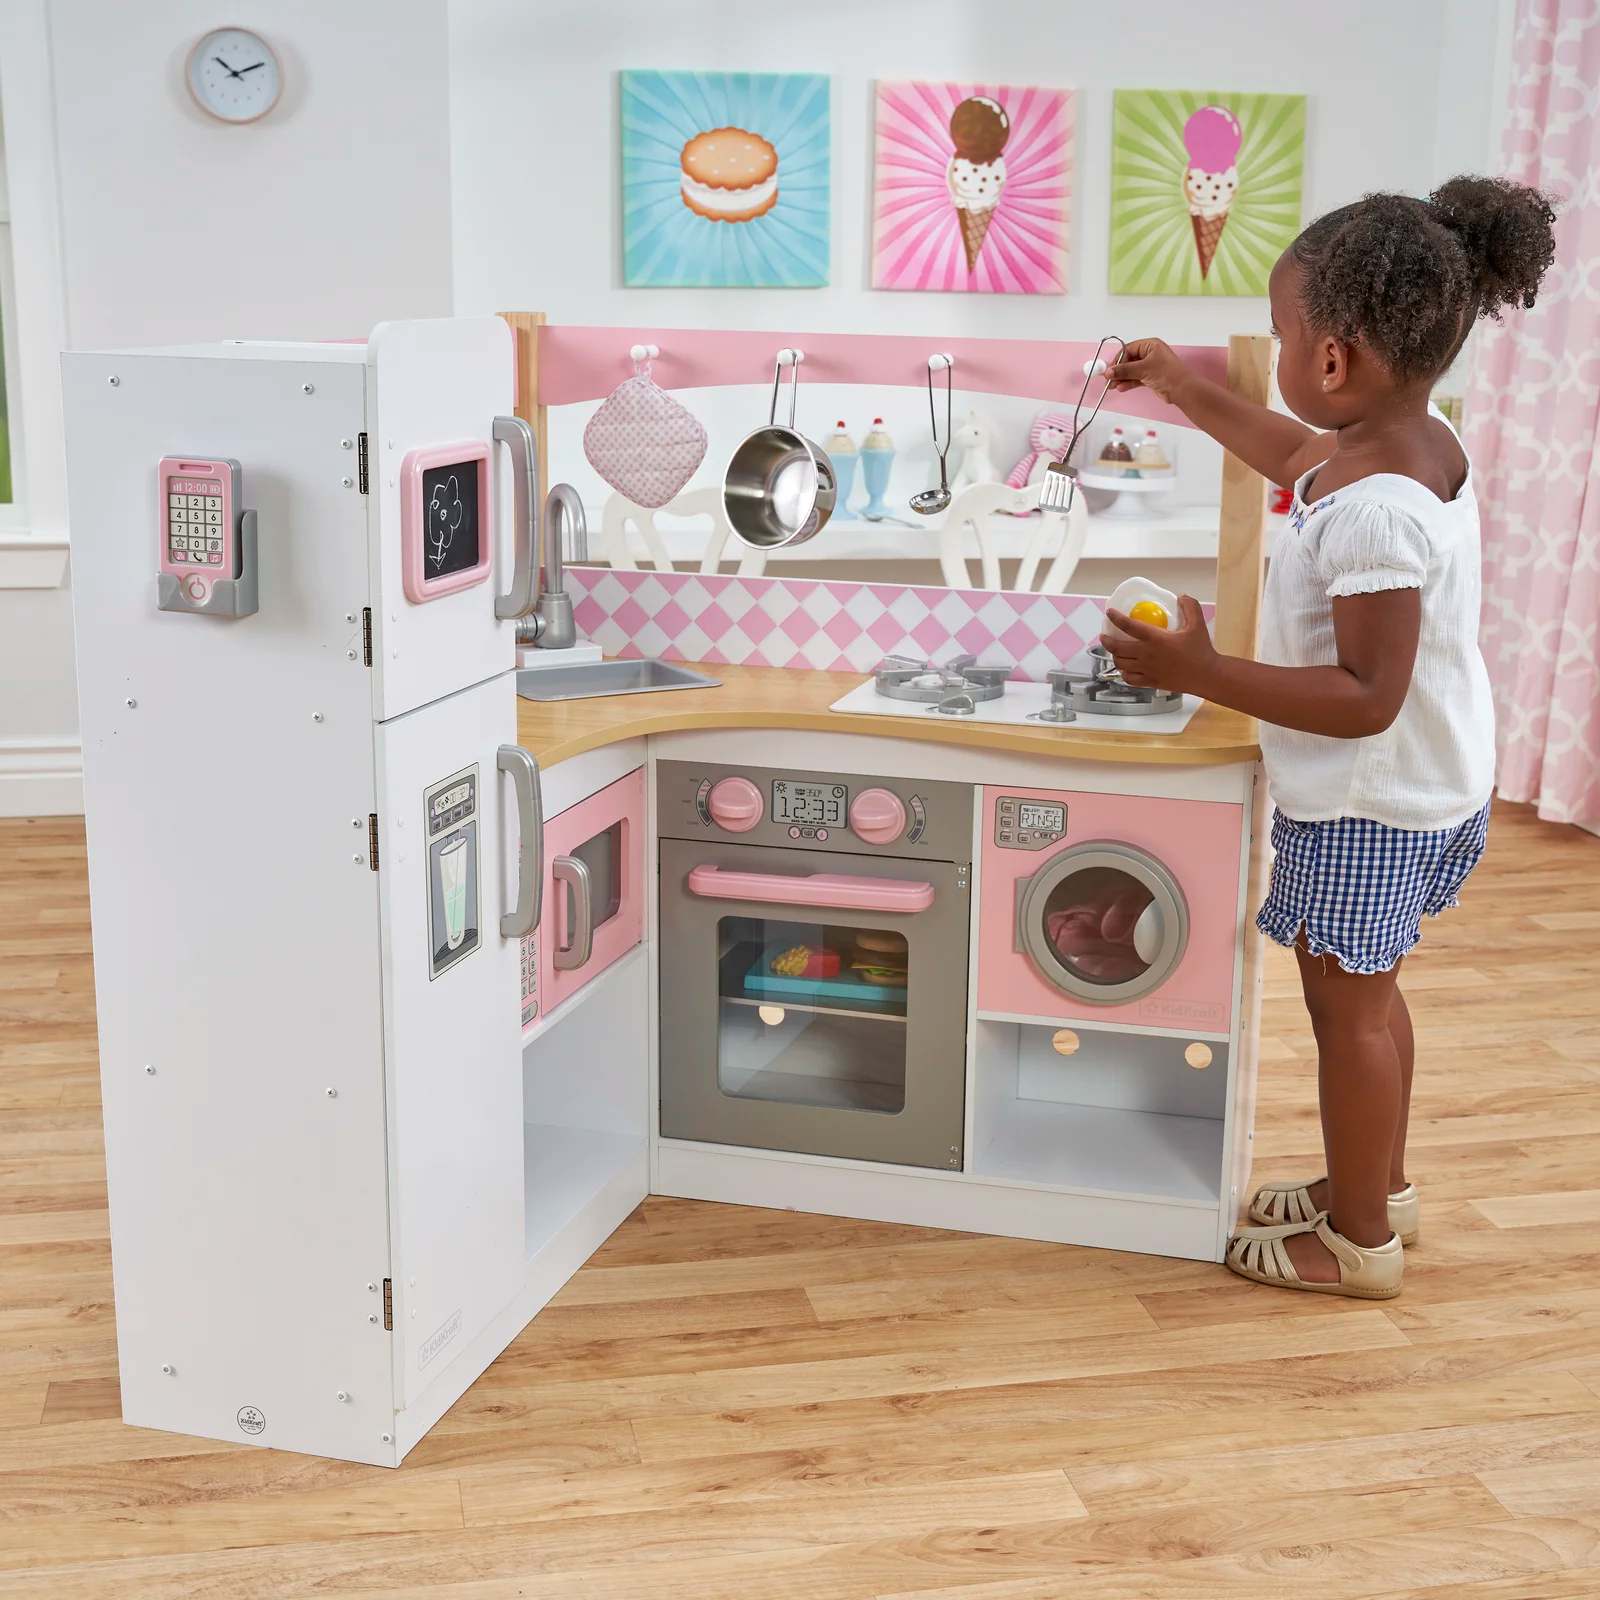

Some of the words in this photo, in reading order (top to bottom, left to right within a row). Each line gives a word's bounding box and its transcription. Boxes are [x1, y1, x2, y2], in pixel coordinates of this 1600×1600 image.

[184, 482, 208, 493] 12:00
[780, 796, 838, 822] 12:33
[1022, 812, 1060, 828] RINSE
[430, 1318, 458, 1355] KidKraft
